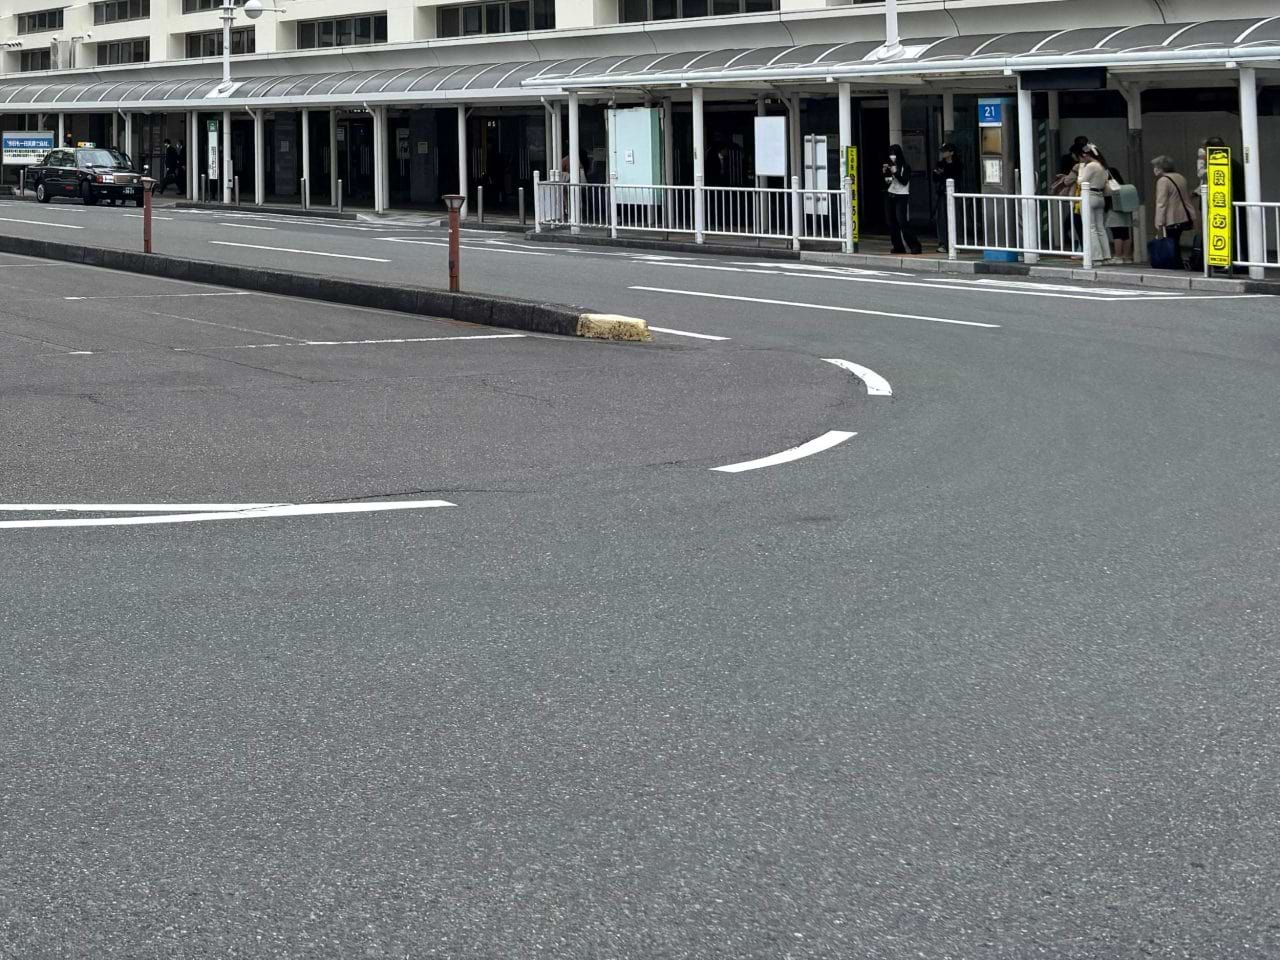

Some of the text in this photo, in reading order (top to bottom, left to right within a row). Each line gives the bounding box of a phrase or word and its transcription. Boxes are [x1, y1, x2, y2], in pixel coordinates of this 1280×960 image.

[984, 106, 995, 117] 21
[1213, 169, 1227, 250] 段差あり
